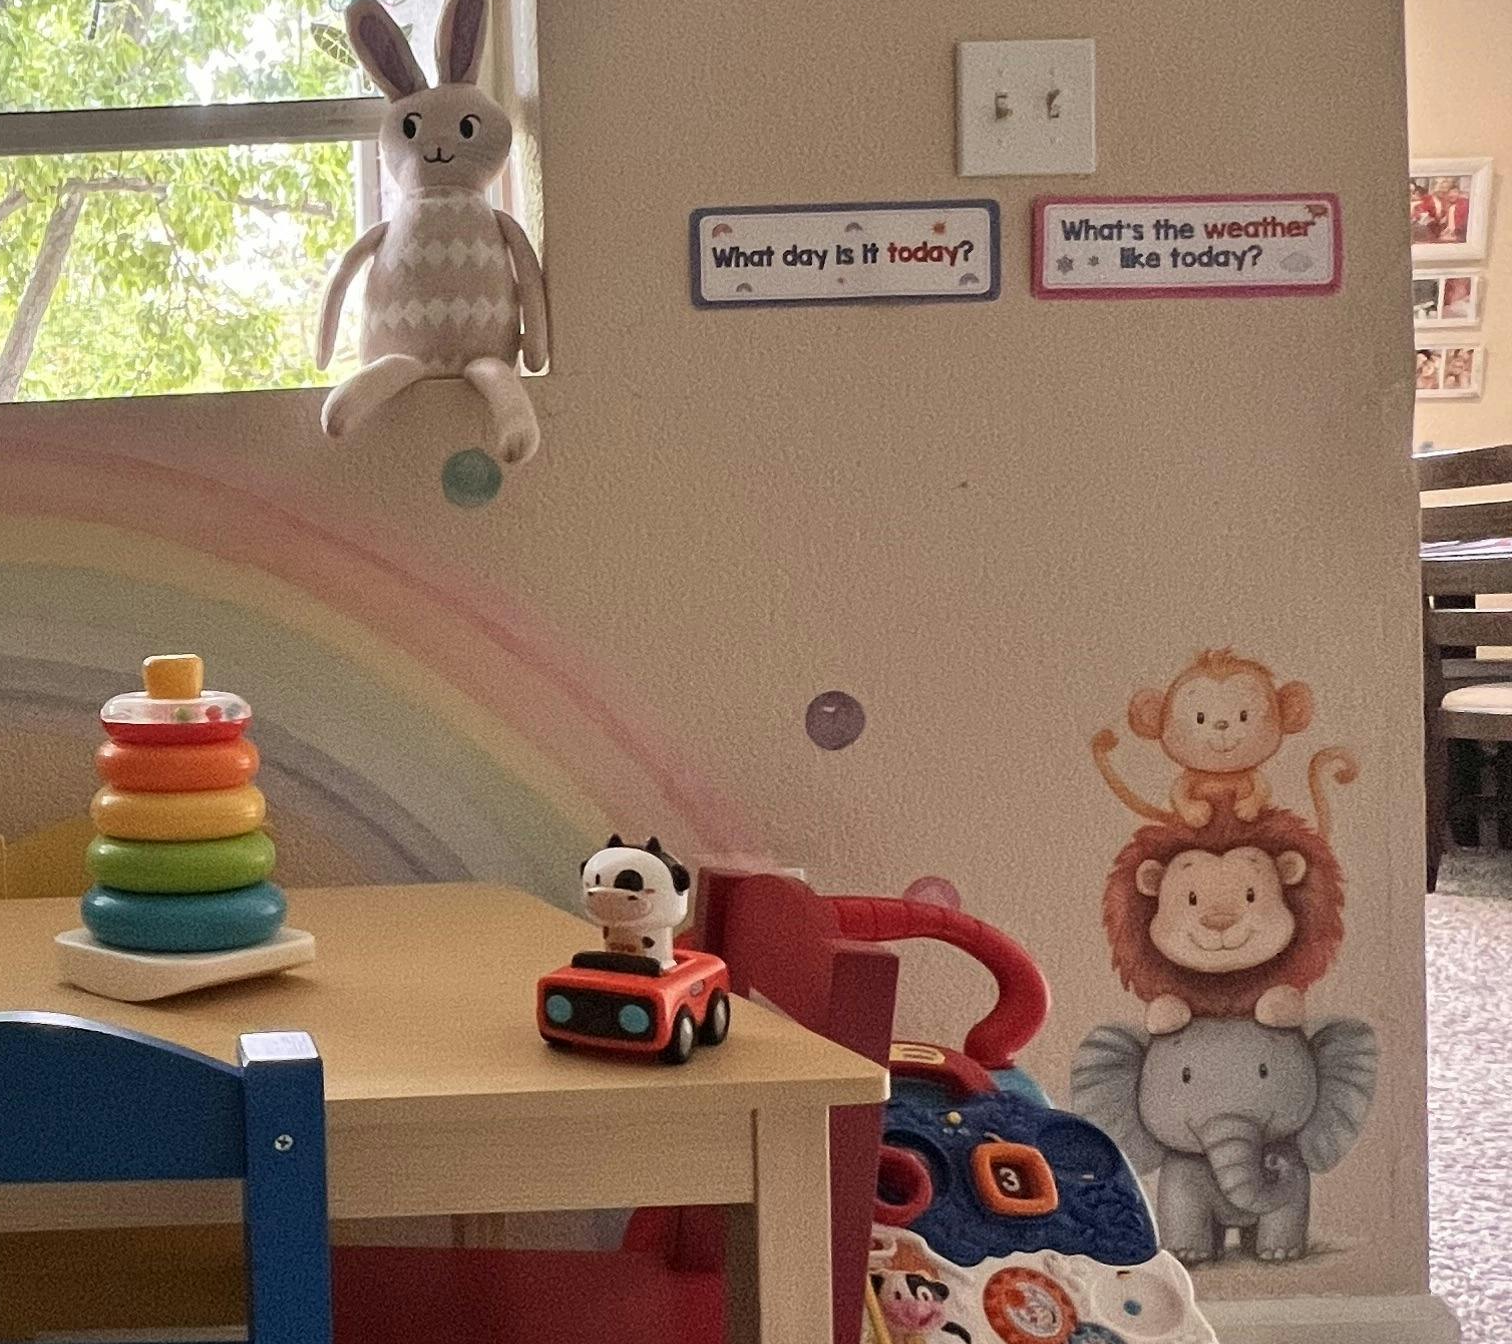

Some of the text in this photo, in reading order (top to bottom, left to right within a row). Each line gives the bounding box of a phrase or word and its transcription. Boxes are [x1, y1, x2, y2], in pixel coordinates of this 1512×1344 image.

[1061, 216, 1317, 241] What's the weather
[712, 240, 975, 270] What day is it today?
[1120, 244, 1264, 271] like today?
[999, 1167, 1021, 1192] 3
